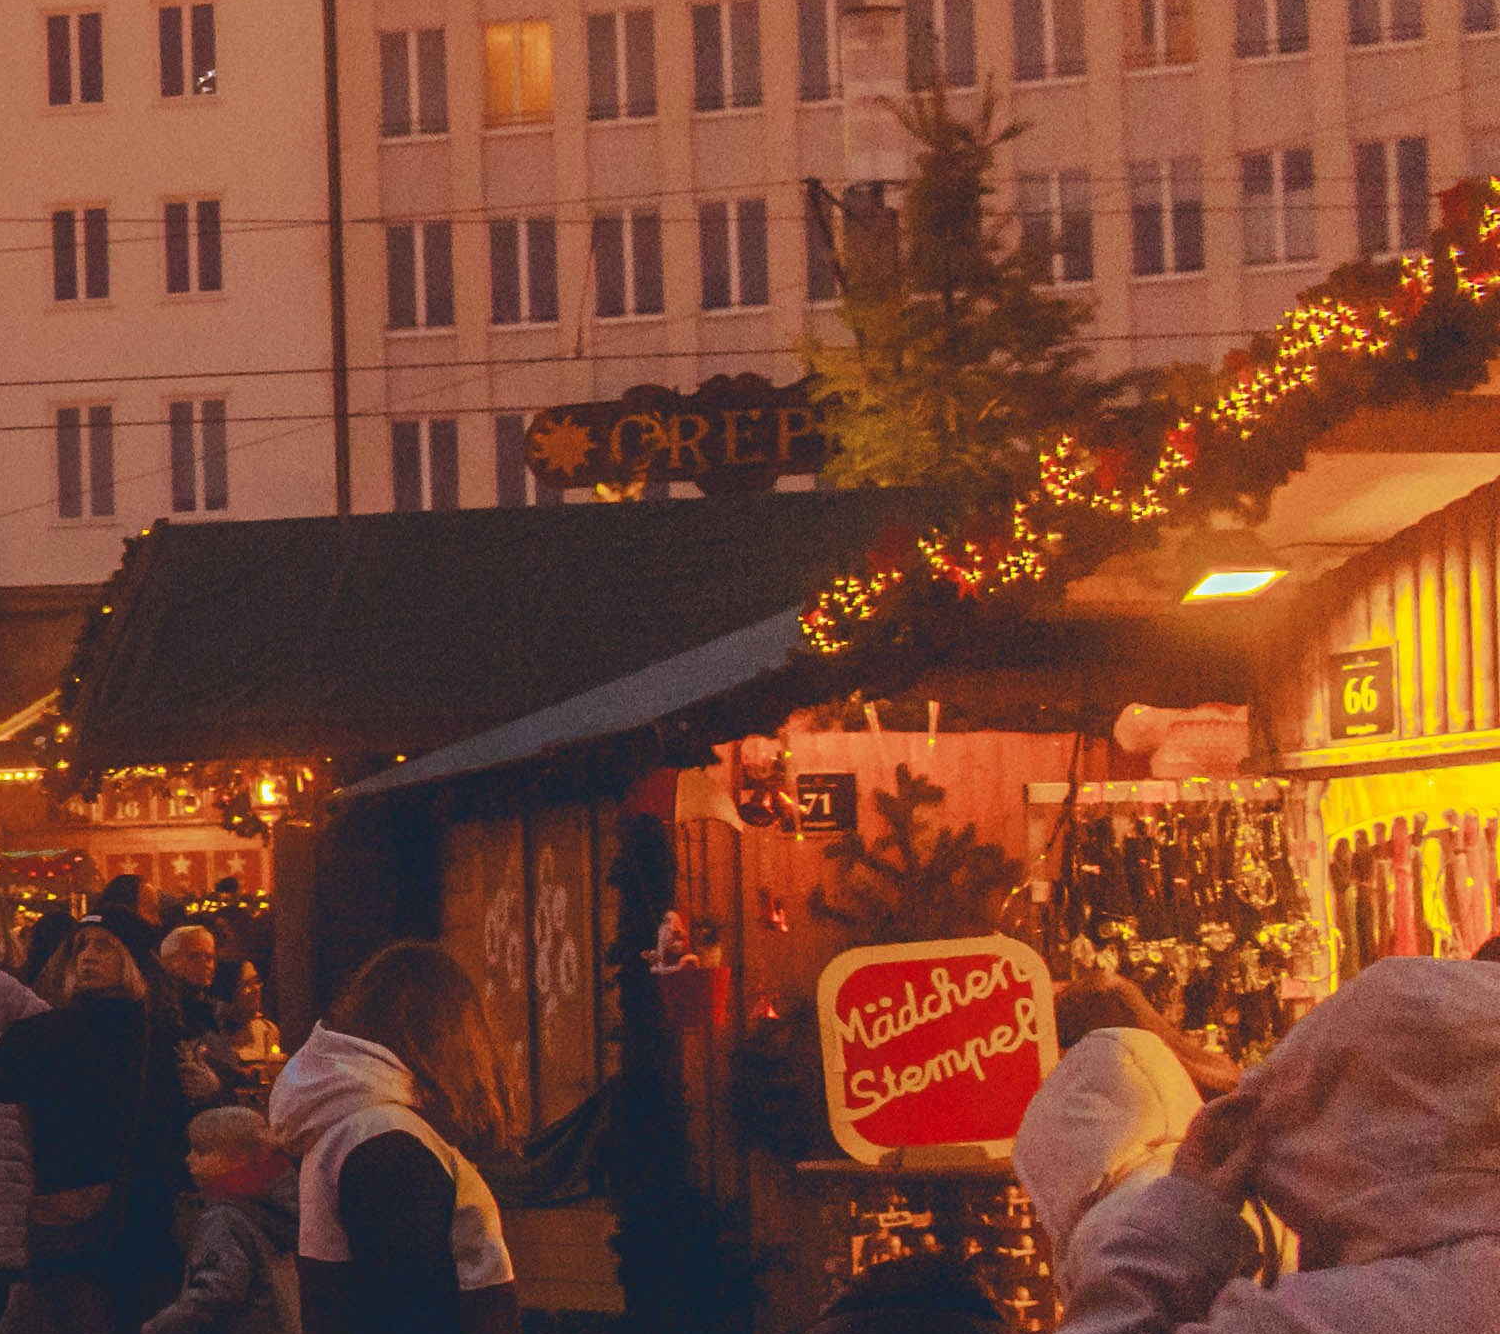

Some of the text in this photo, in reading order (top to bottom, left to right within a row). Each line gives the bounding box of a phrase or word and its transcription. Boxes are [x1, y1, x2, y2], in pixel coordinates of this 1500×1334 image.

[608, 407, 818, 470] CREP
[1343, 675, 1378, 715] 66
[802, 792, 832, 816] 71
[833, 955, 1036, 1049] Mädchen
[836, 997, 1046, 1121] Stempel
